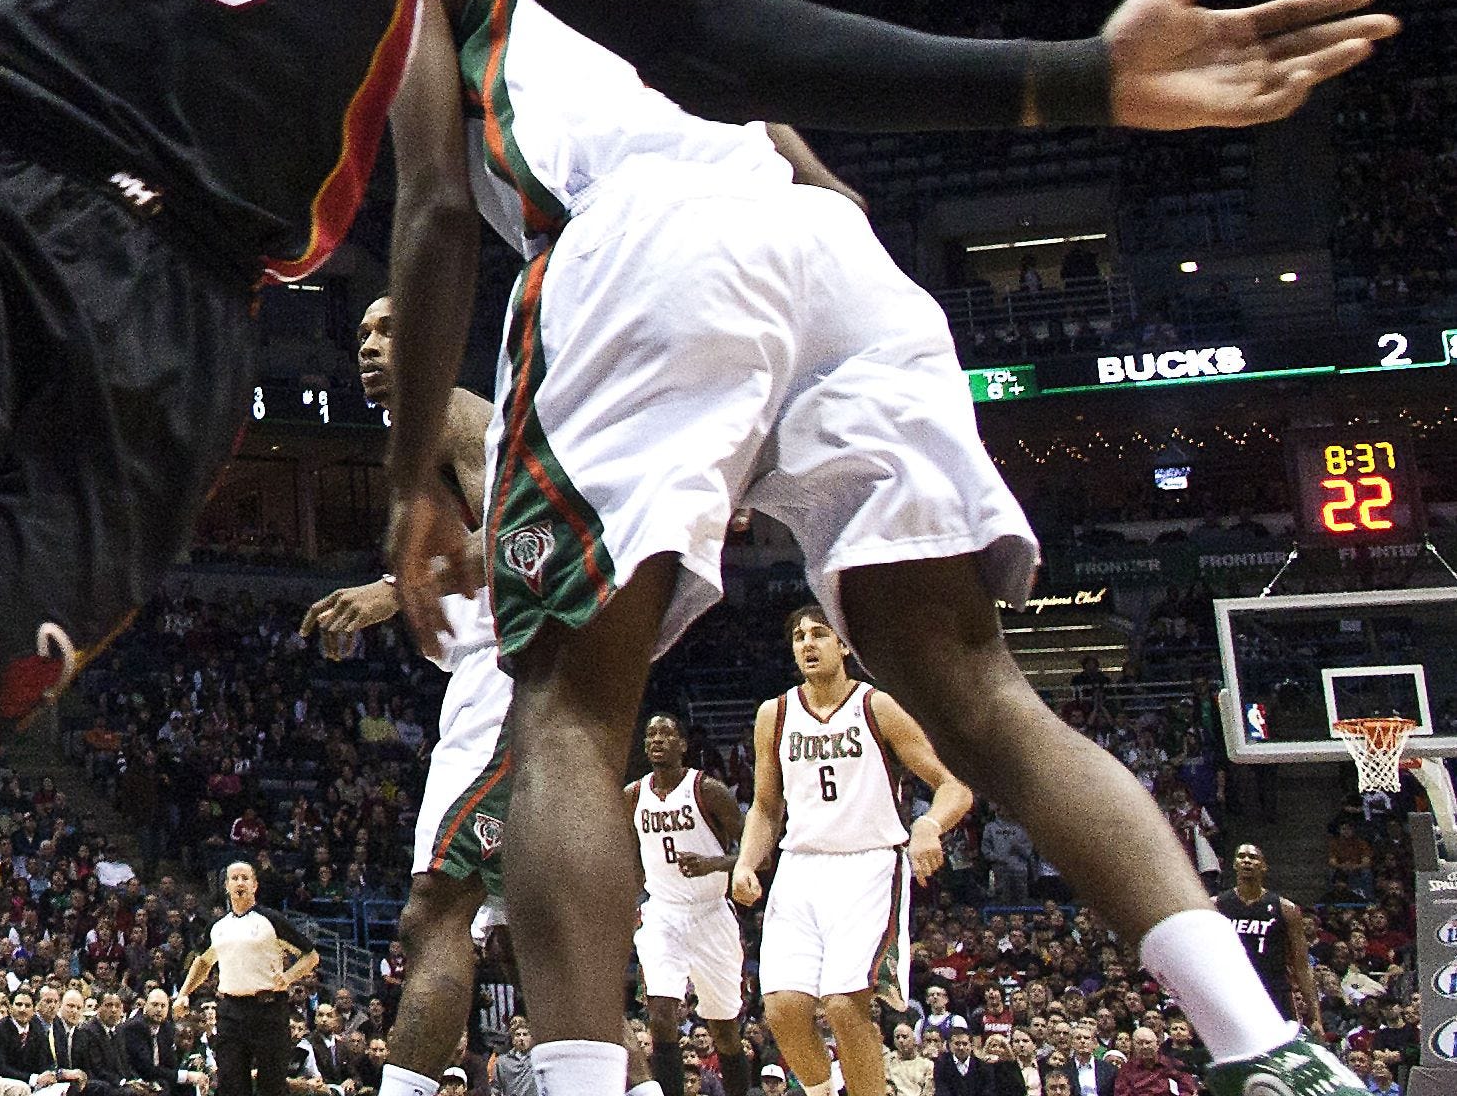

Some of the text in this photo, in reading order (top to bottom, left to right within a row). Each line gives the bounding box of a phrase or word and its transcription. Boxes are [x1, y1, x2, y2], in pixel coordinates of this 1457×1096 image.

[1097, 346, 1246, 383] BUCKS
[1378, 332, 1412, 367] 2
[1324, 441, 1396, 475] 8:37
[1320, 476, 1393, 532] 22
[788, 726, 863, 762] BUCKS
[818, 765, 838, 802] 6
[641, 804, 696, 834] BUCKS
[1258, 937, 1266, 954] 1
